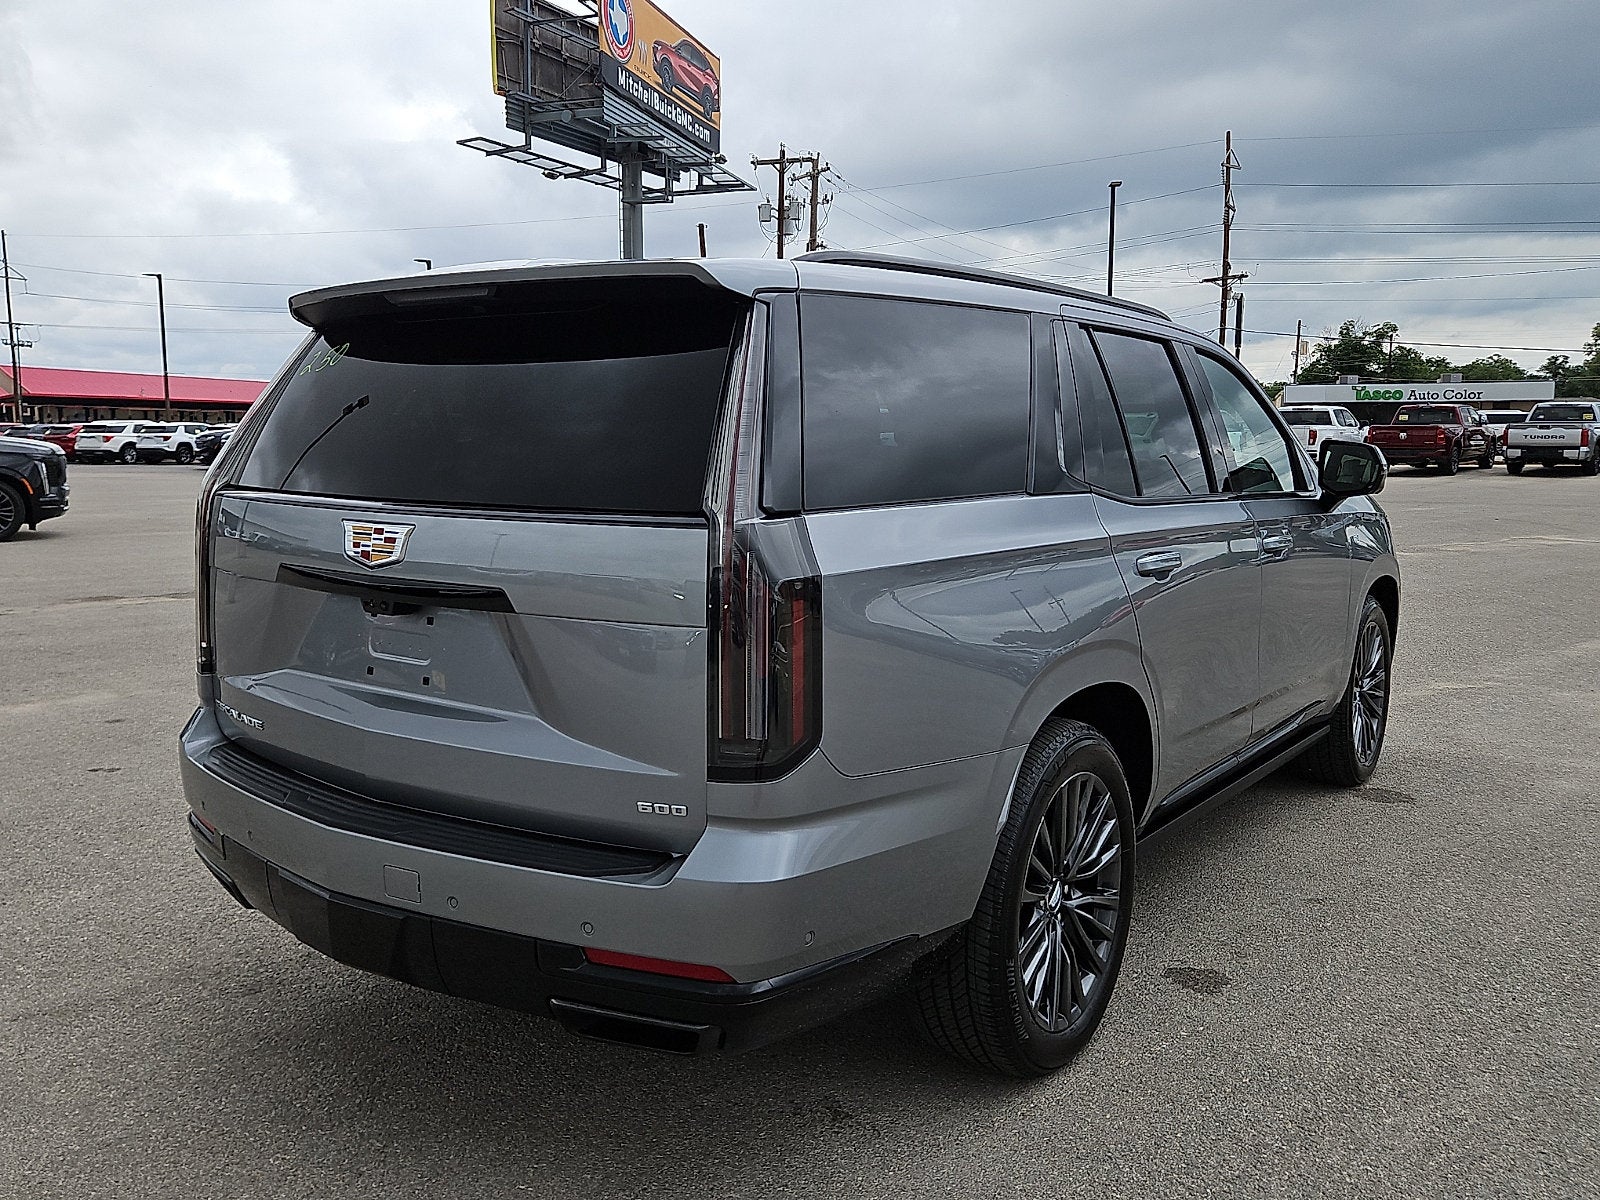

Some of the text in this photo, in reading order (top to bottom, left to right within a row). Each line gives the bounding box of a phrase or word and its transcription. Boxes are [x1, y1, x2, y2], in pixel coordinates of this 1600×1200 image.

[617, 66, 710, 143] MitchellBuickGMC.com
[1352, 386, 1484, 400] TASCO Auto Color
[636, 801, 688, 817] 600
